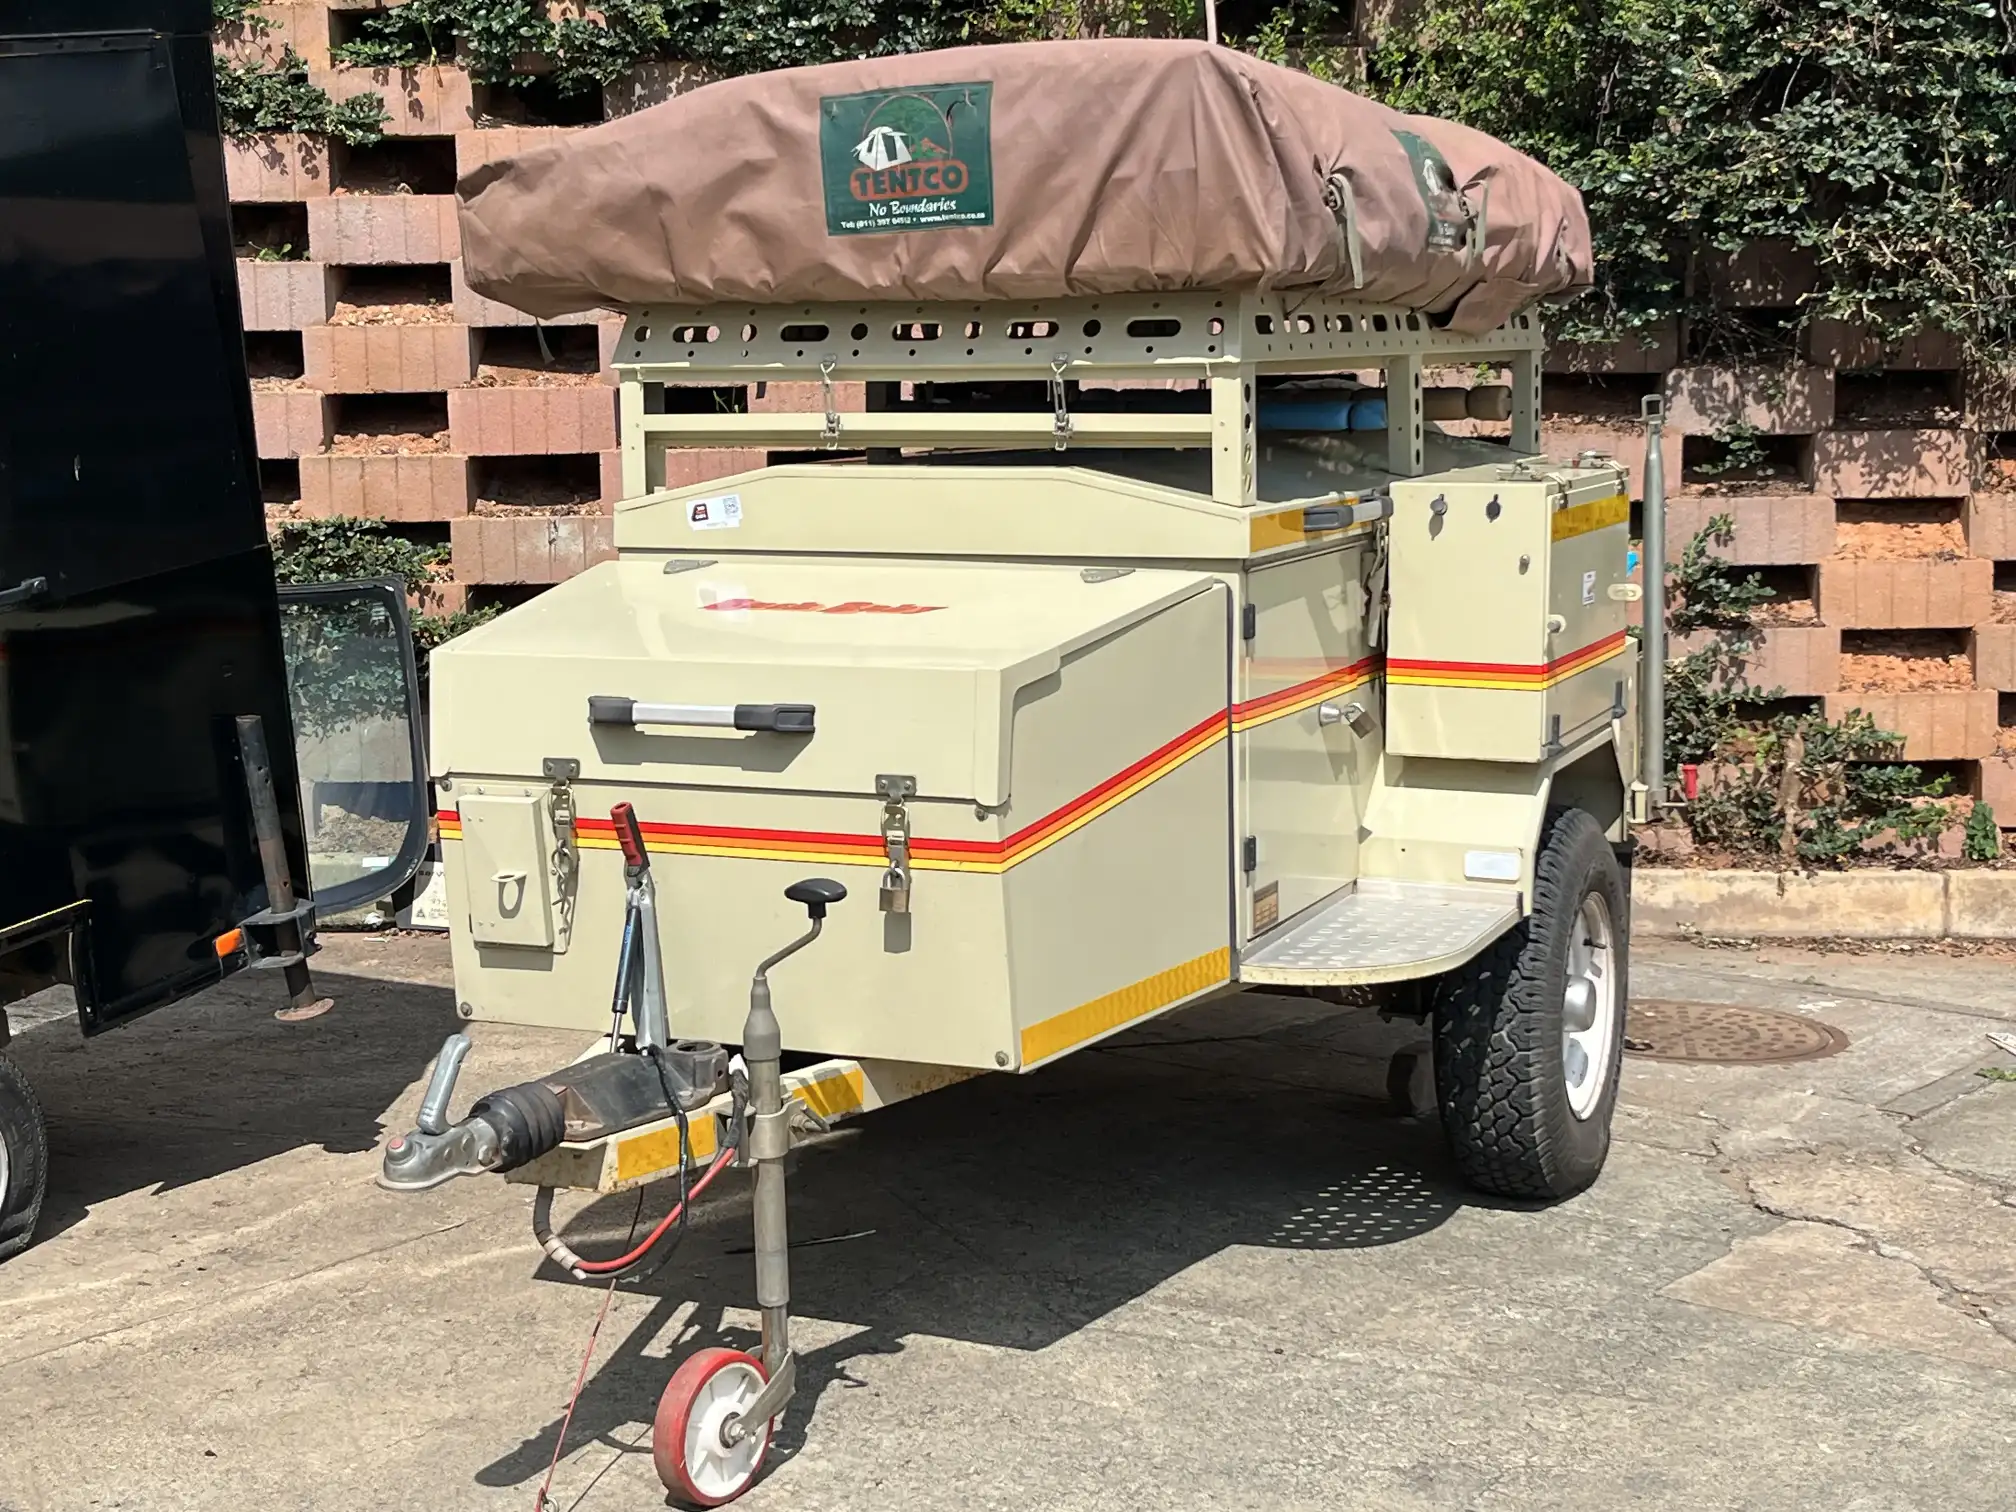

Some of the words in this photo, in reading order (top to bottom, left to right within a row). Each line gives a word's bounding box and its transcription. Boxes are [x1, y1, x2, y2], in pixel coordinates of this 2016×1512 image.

[854, 164, 963, 196] TENTCO
[869, 202, 887, 218] No
[889, 197, 957, 215] Boundaries
